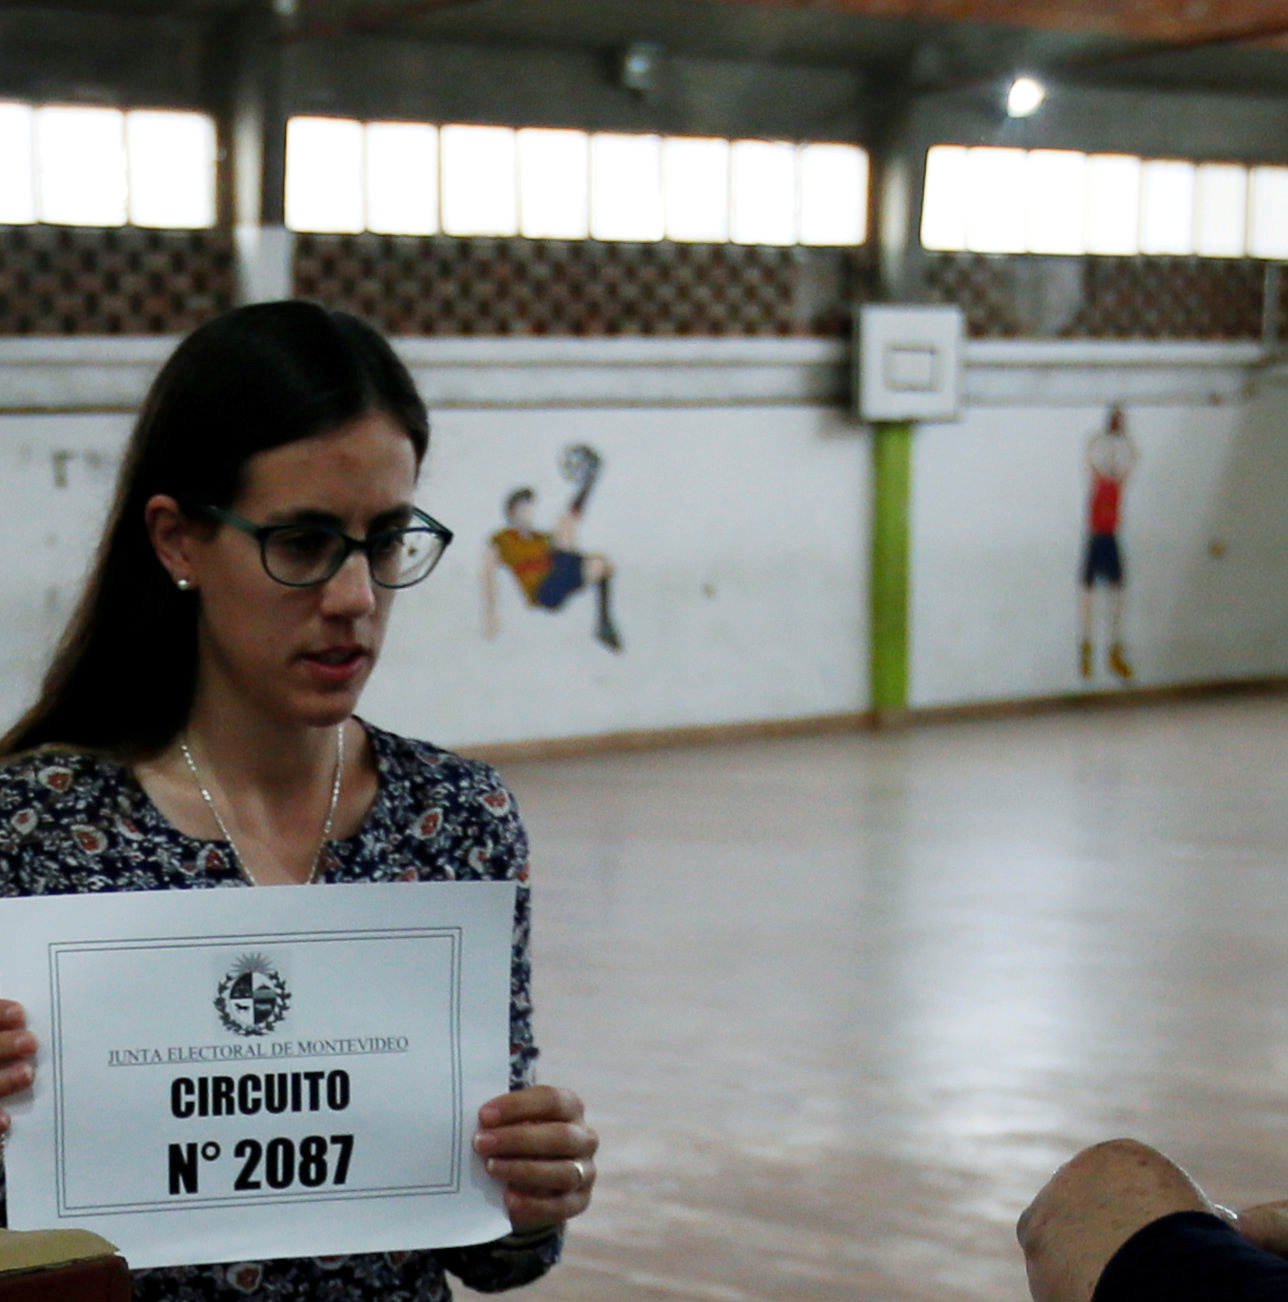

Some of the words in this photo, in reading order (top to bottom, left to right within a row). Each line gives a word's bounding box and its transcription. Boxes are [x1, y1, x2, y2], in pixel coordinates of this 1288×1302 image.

[108, 1049, 162, 1065] JUNTA
[168, 1043, 263, 1061] ELECTORAL
[271, 1041, 291, 1056] DE
[295, 1036, 409, 1055] MONTEVIDEO
[170, 1069, 350, 1118] CIRCUITO
[233, 1134, 354, 1191] 2087
